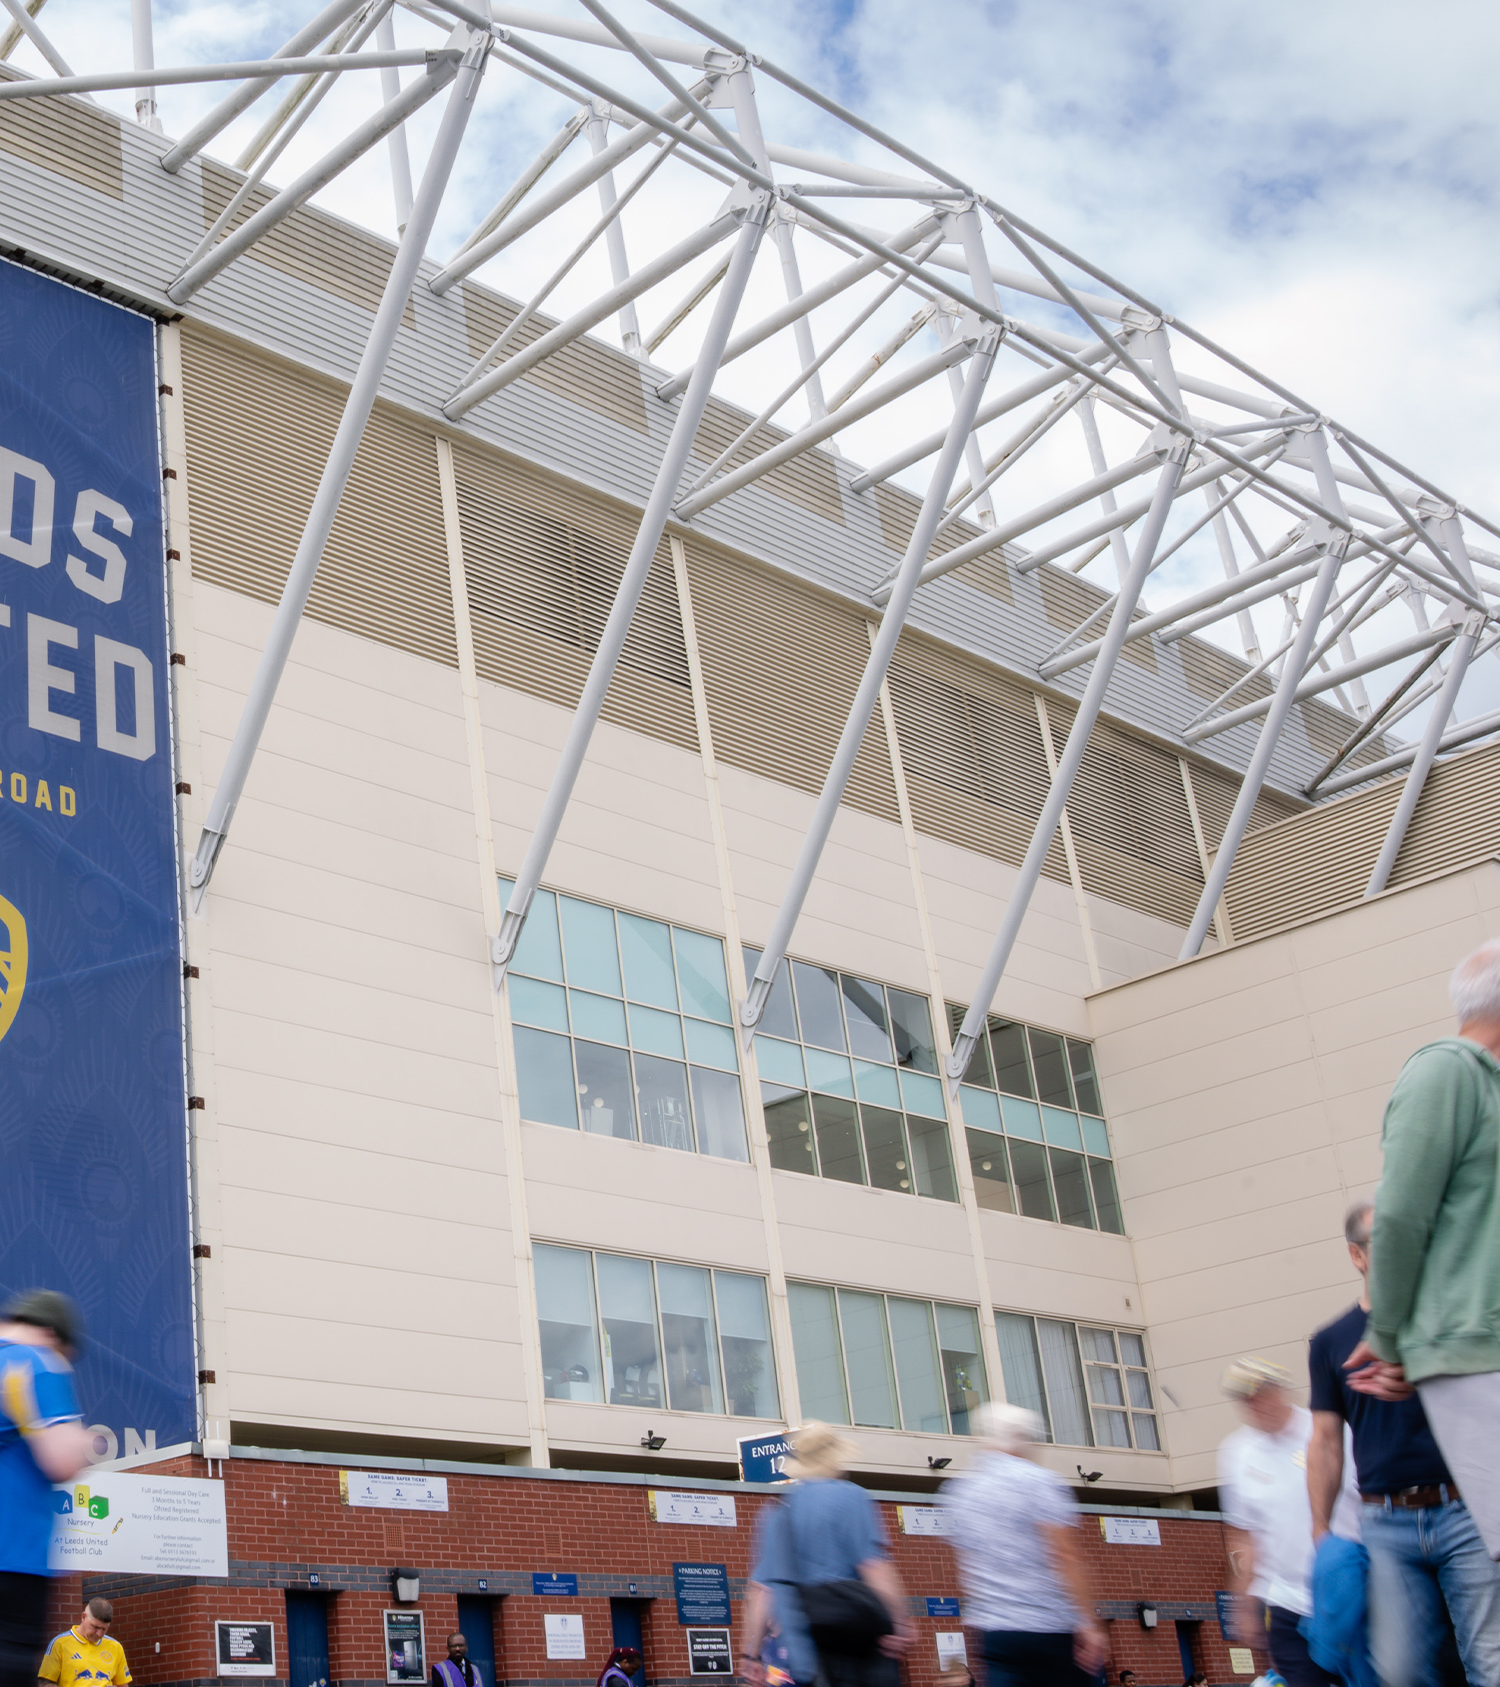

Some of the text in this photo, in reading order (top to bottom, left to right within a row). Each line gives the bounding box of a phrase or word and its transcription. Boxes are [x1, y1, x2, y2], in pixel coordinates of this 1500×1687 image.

[751, 1440, 797, 1458] ENTRANC
[770, 1455, 787, 1474] 12
[163, 1488, 187, 1496] Sessional
[187, 1490, 197, 1498] Day
[366, 1486, 434, 1499] 1. 2. 3.
[172, 1506, 199, 1514] Registered
[67, 1518, 95, 1528] Nursery
[131, 1513, 152, 1521] Nursery
[197, 1517, 221, 1525] Accepted
[64, 1537, 84, 1545] Leeds
[86, 1538, 108, 1546] United
[60, 1546, 103, 1556] Football Club
[681, 1567, 720, 1576] PARKING NOTICE
[310, 1574, 319, 1583] 83
[479, 1580, 488, 1589] 82
